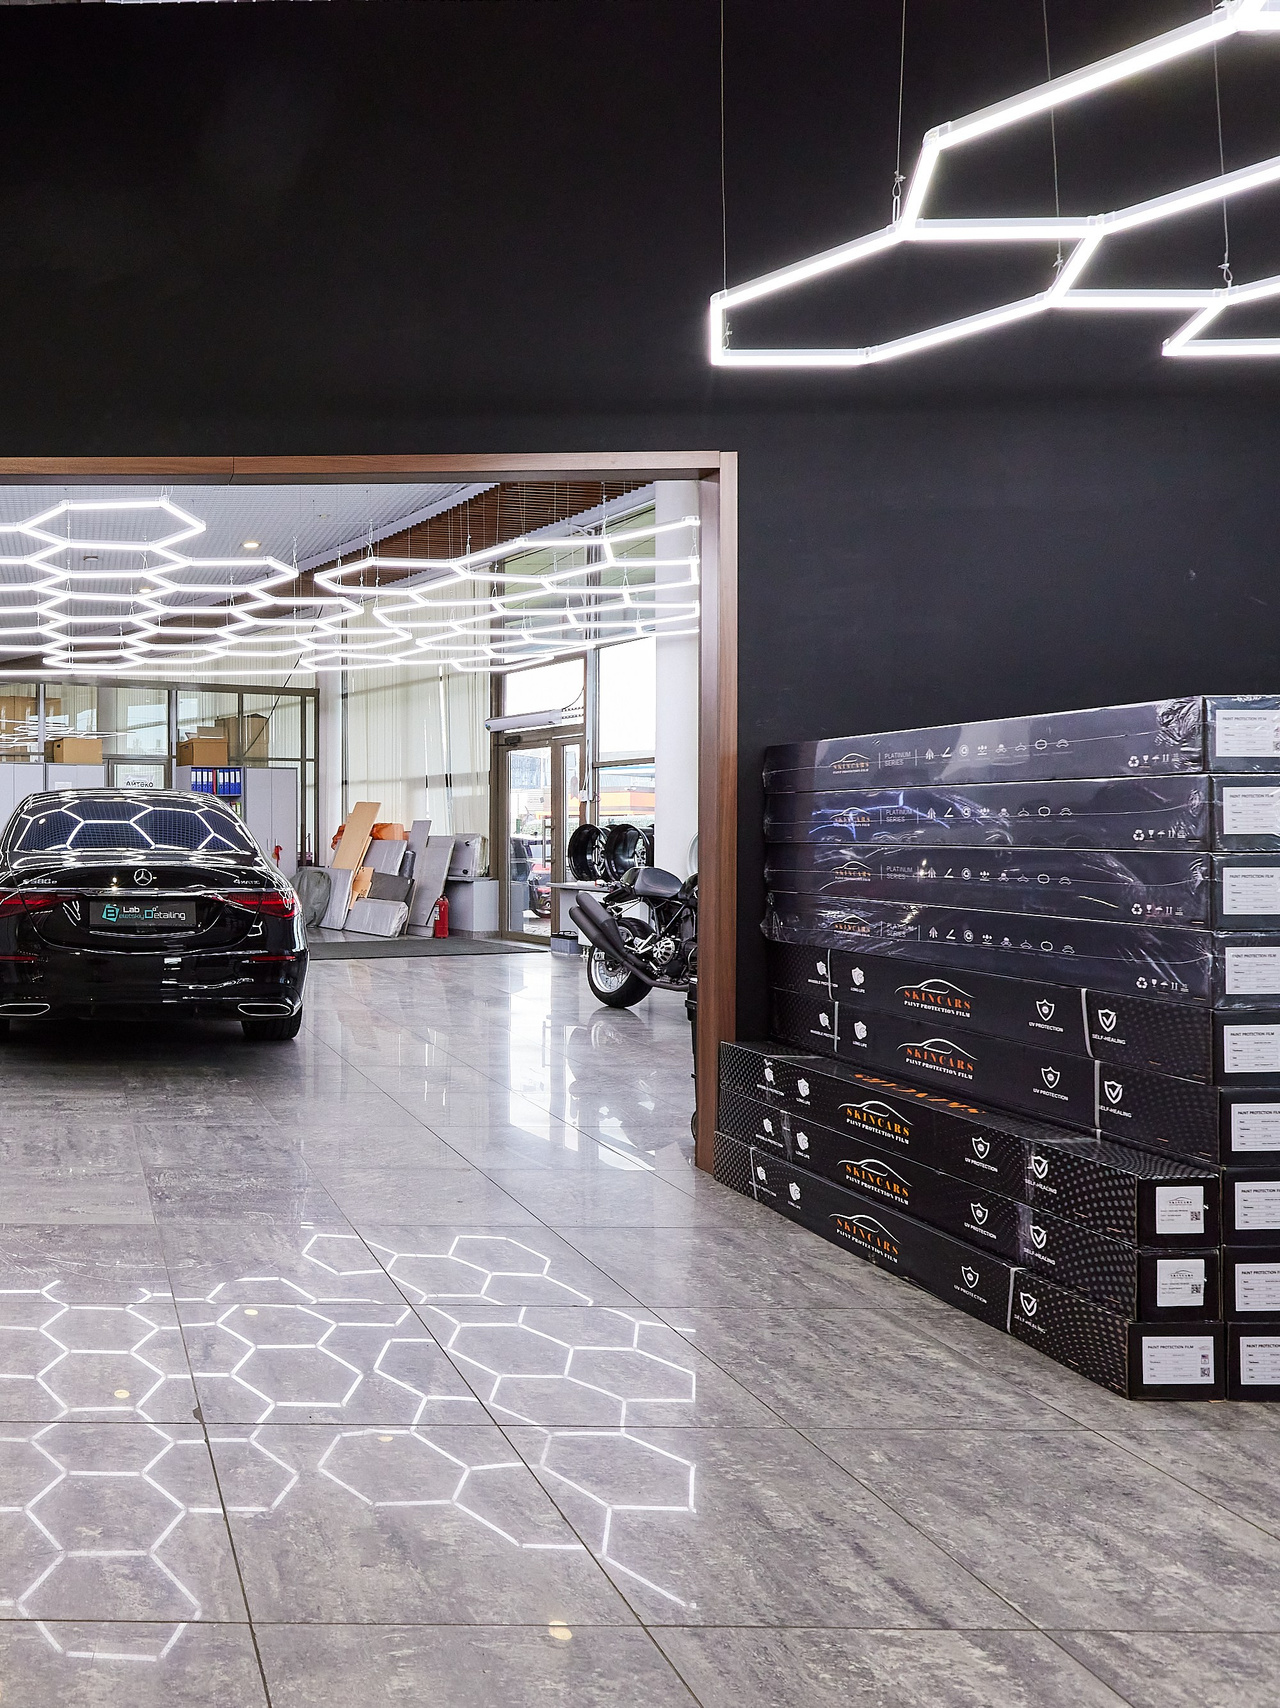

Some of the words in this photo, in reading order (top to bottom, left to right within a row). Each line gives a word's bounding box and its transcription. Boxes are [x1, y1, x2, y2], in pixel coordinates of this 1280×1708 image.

[884, 751, 911, 760] PLATINUM
[884, 759, 904, 767] SERIES
[904, 989, 971, 1010] SKINCARS
[904, 1000, 920, 1009] PAINT
[920, 1003, 955, 1015] PROTECTION
[955, 1008, 971, 1018] FILM
[1035, 1022, 1063, 1032] PROTECTION
[1091, 1033, 1126, 1045] SELF-HEALING
[906, 1047, 974, 1072] SKINCARS
[906, 1057, 922, 1067] PAINT
[922, 1061, 957, 1076] PROTECTION
[957, 1070, 973, 1080] FILM
[1040, 1089, 1068, 1101] PROTECTION
[1099, 1105, 1132, 1118] ELF-HEALING
[846, 1107, 910, 1137] SKINCARS
[846, 1118, 861, 1129] PAINT
[861, 1123, 895, 1140] PROTECTION
[895, 1134, 909, 1145] FILM
[971, 1159, 998, 1173] PROTECTION
[845, 1164, 909, 1198] SKINCARS
[845, 1174, 860, 1186] PAINT
[860, 1180, 894, 1201] PROTECTION
[894, 1194, 909, 1206] FILM
[836, 1218, 899, 1255] SKINCARS
[970, 1224, 997, 1240] PROTECTION
[836, 1228, 851, 1240] PAINT
[851, 1235, 884, 1257] PROTECTION
[884, 1251, 898, 1264] FILM
[960, 1287, 987, 1304] PROTECTION
